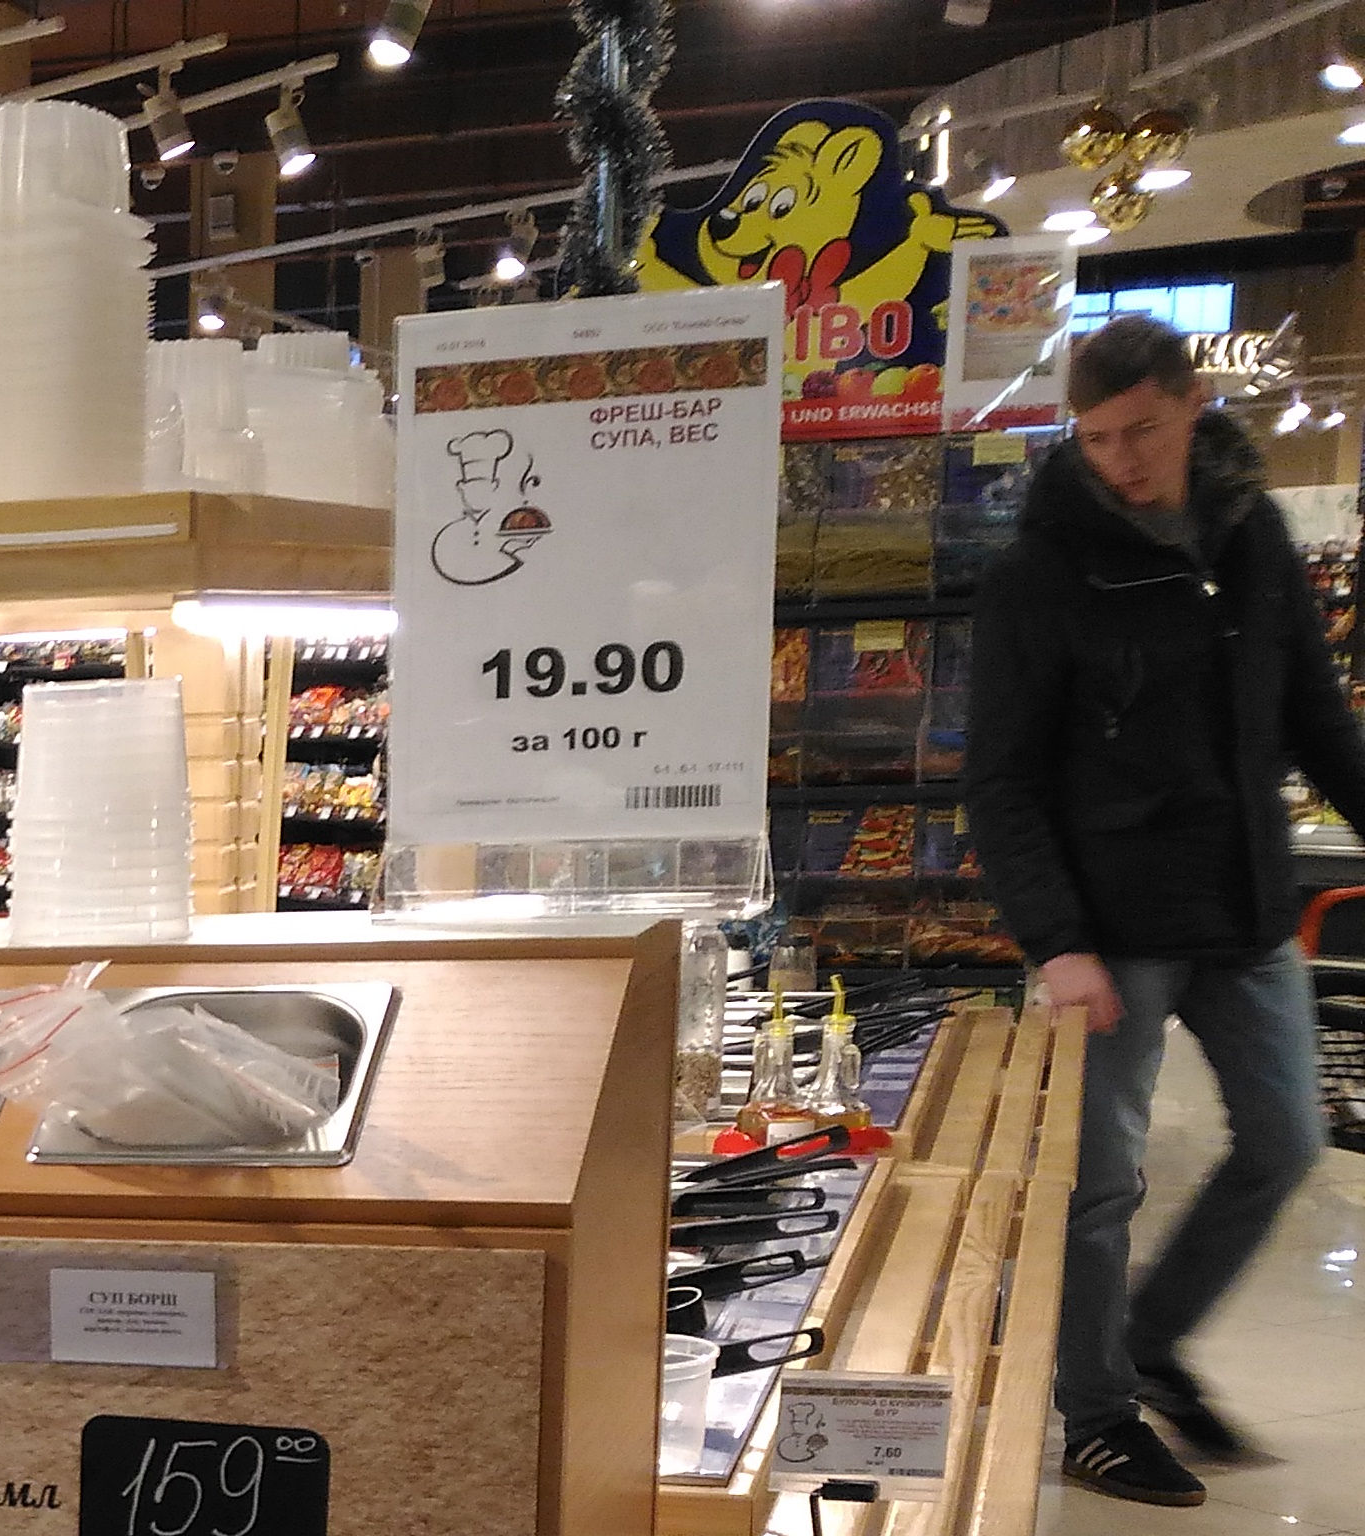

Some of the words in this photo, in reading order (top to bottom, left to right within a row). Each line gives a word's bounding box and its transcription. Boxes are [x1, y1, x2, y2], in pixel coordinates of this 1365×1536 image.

[793, 300, 914, 362] IBO
[589, 398, 722, 425] ФРЕШ-БАР
[790, 407, 834, 424] UND
[837, 400, 943, 421] ERWACHSE
[590, 429, 661, 450] СУПА,
[670, 423, 719, 443] ВЕС
[481, 640, 685, 699] 19.90
[510, 734, 550, 752] за
[562, 726, 621, 751] 100
[632, 729, 648, 748] г
[89, 1292, 123, 1304] СУП
